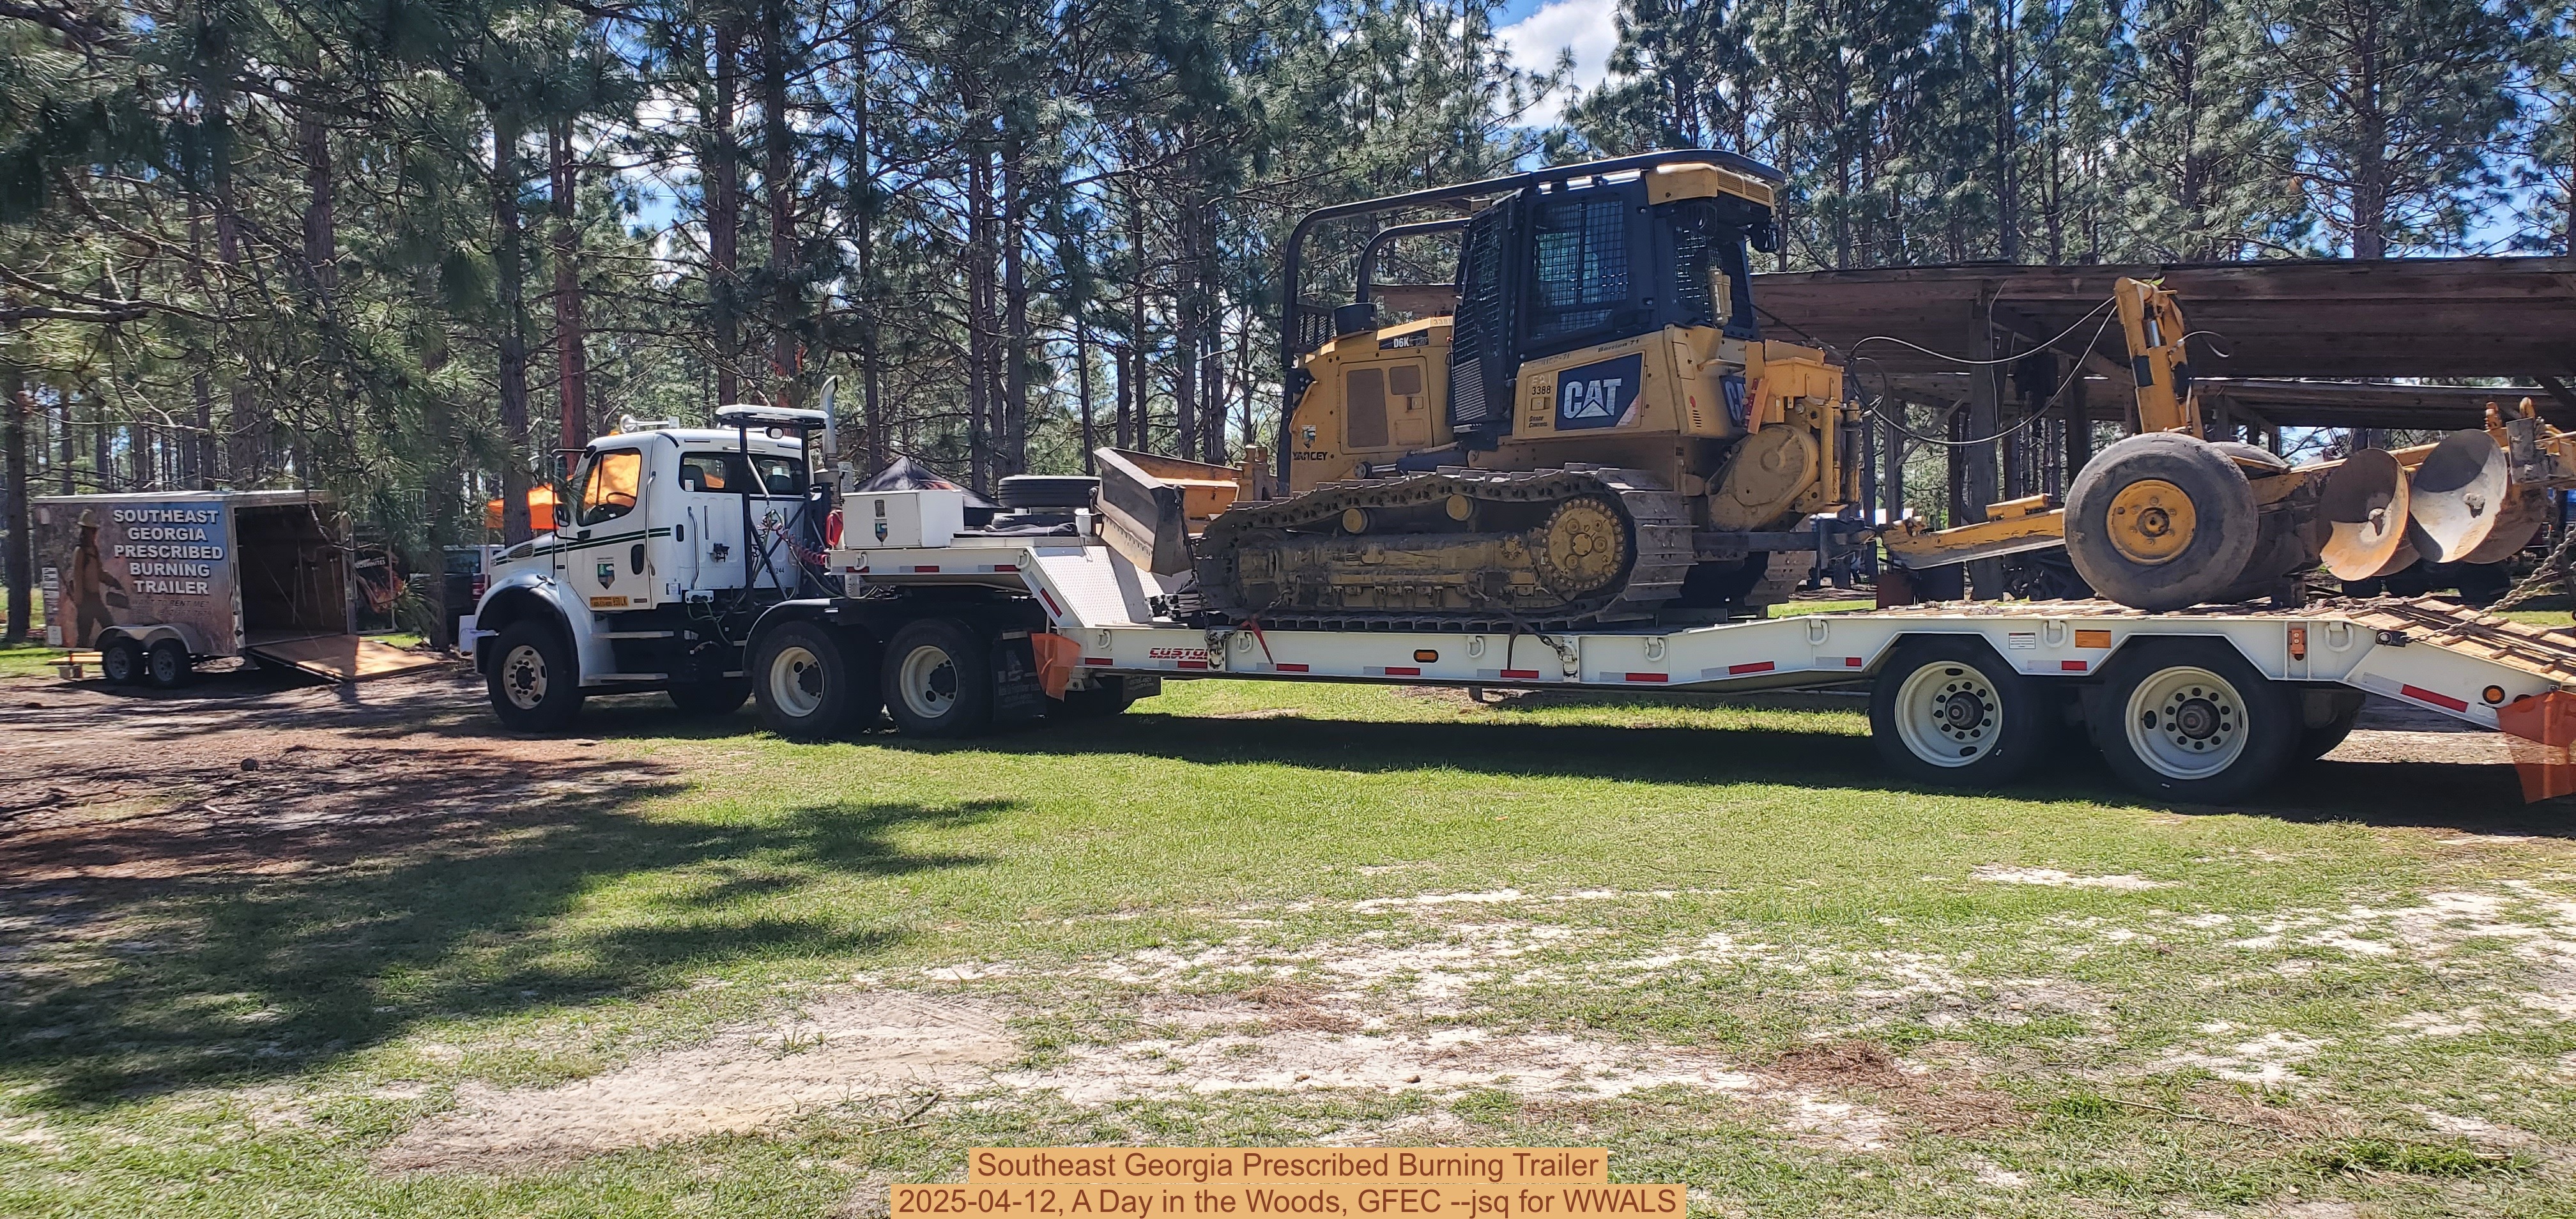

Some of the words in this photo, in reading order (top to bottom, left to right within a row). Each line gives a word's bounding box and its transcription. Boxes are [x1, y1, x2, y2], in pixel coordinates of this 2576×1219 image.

[1531, 385, 1551, 395] 3388
[1563, 378, 1622, 418] CAT
[1292, 452, 1328, 460] YANCEY
[113, 509, 218, 524] SOUTHEAST
[128, 527, 208, 541] GEORGIA
[114, 544, 224, 560] PRESCRIBED
[130, 562, 211, 577] BURNING
[133, 580, 210, 595] TRAILER
